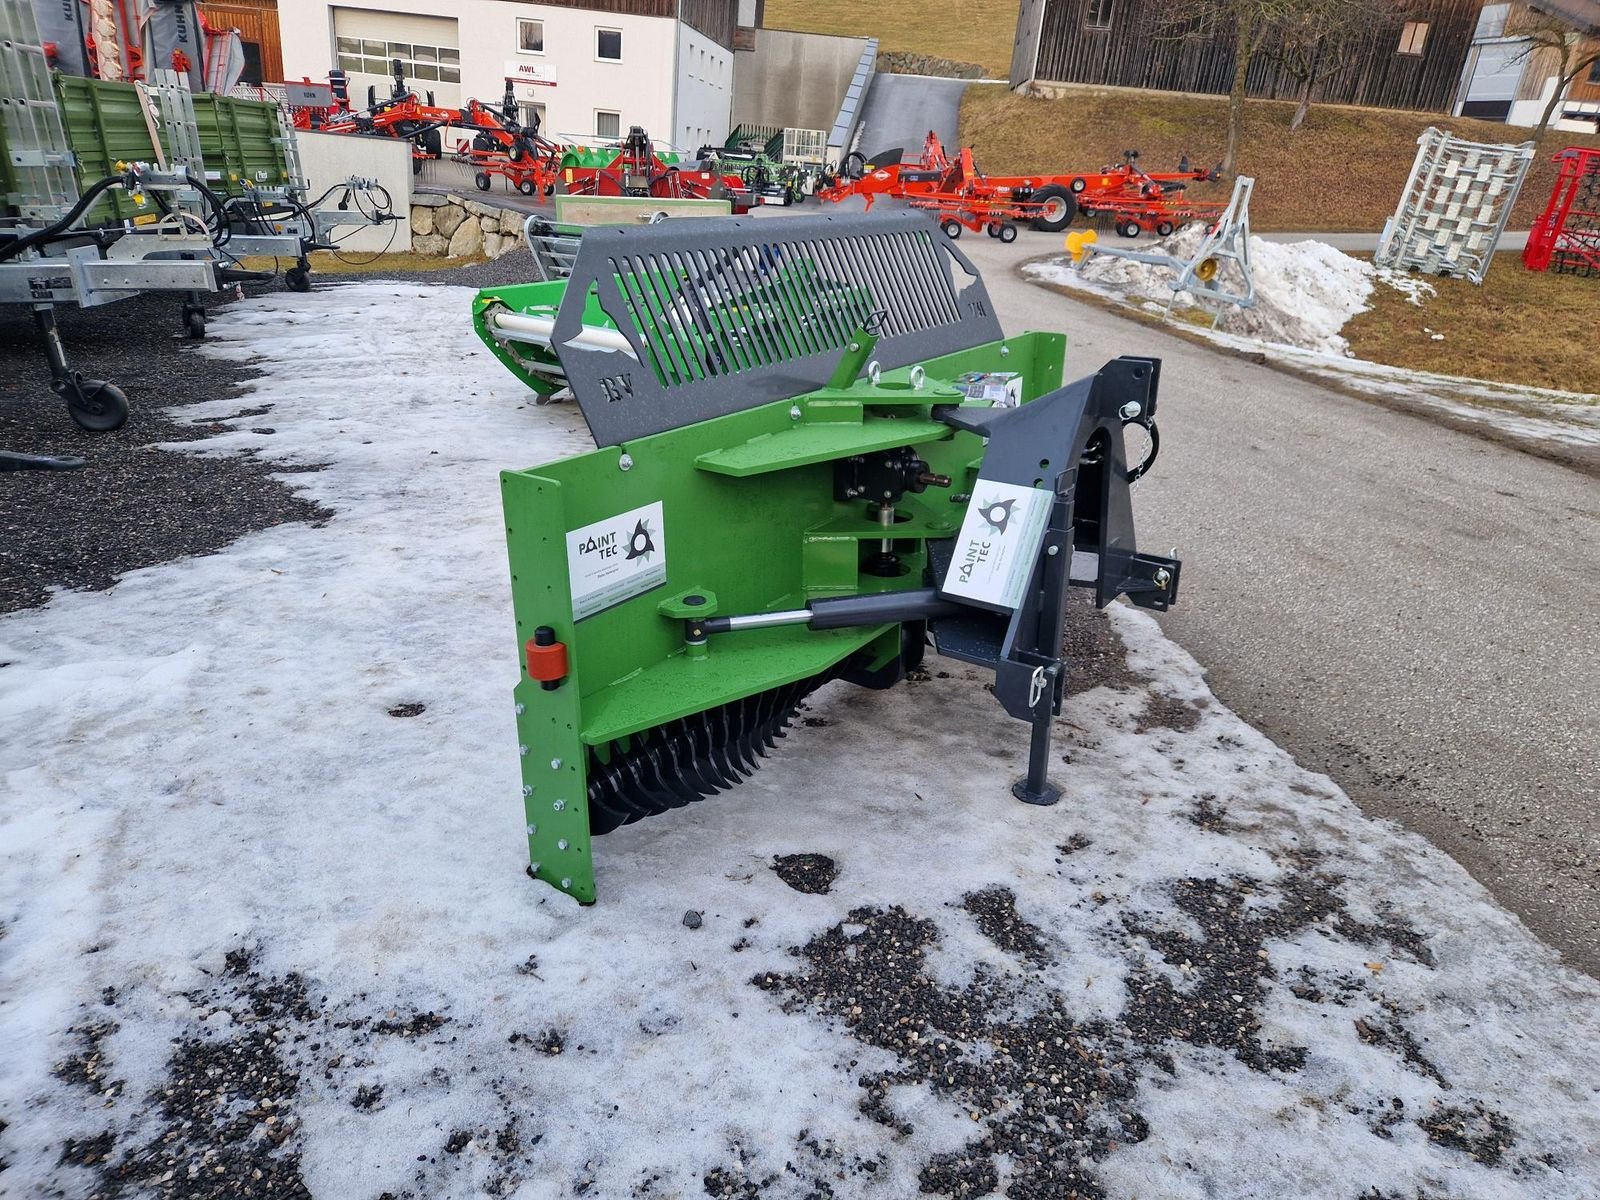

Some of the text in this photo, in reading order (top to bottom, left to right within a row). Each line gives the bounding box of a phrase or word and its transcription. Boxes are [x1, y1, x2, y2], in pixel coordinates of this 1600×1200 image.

[62, 0, 73, 20] KU
[174, 4, 188, 43] KUHN
[519, 65, 536, 73] AWL
[598, 544, 618, 559] TEC
[976, 541, 992, 563] TEC
